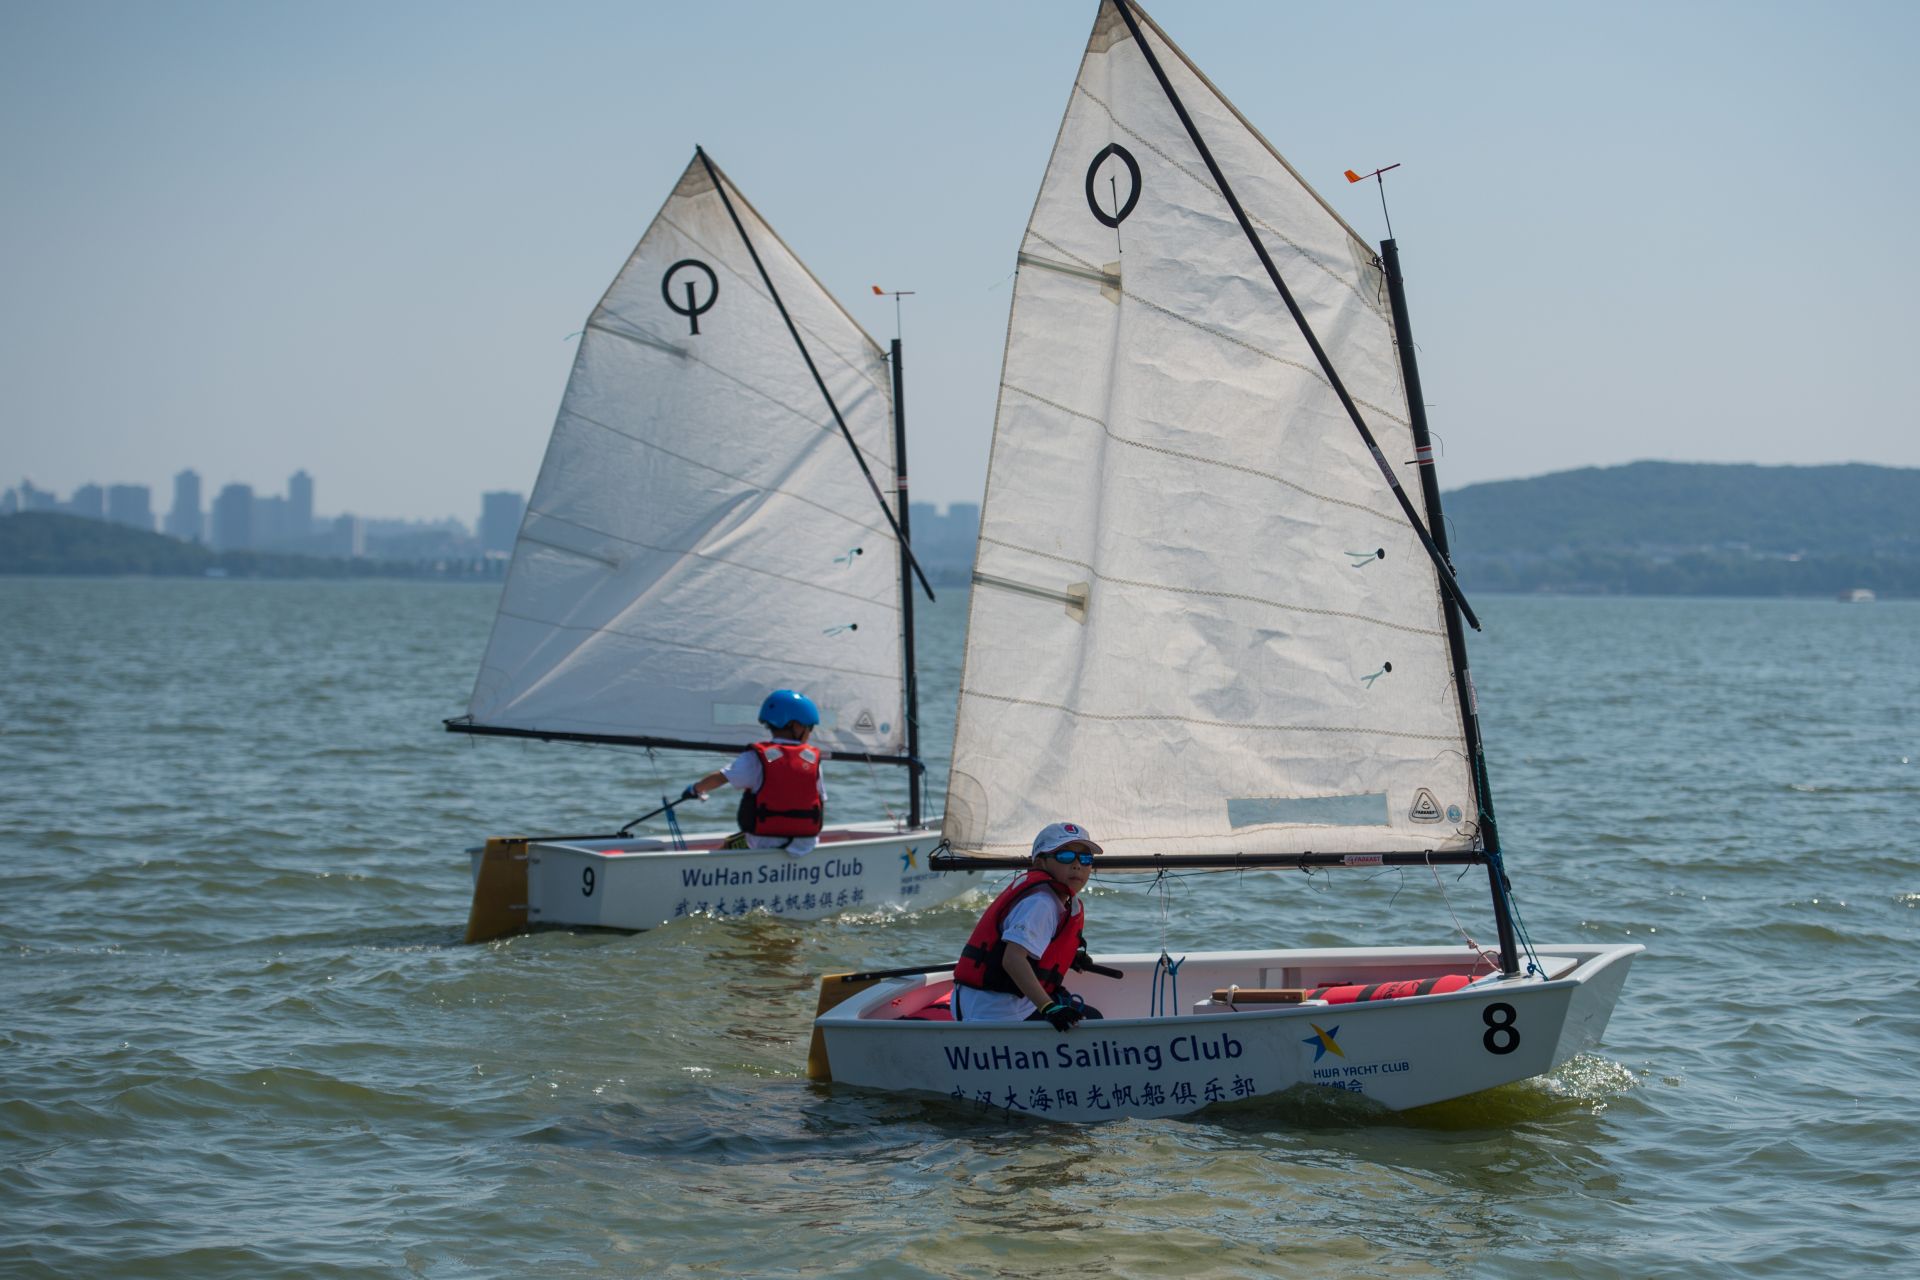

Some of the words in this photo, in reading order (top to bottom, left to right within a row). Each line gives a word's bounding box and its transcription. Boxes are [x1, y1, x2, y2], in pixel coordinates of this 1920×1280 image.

[582, 866, 595, 897] 9
[682, 867, 752, 887] WuHan
[757, 863, 820, 884] Sailing
[824, 857, 863, 878] Club
[1482, 1002, 1520, 1055] 8
[944, 1045, 1049, 1070] WuHan
[1056, 1040, 1162, 1071] Sailing
[1170, 1033, 1243, 1062] Club
[1313, 1068, 1340, 1078] HWA
[1342, 1065, 1378, 1076] YACHT
[1382, 1062, 1410, 1073] CLUB
